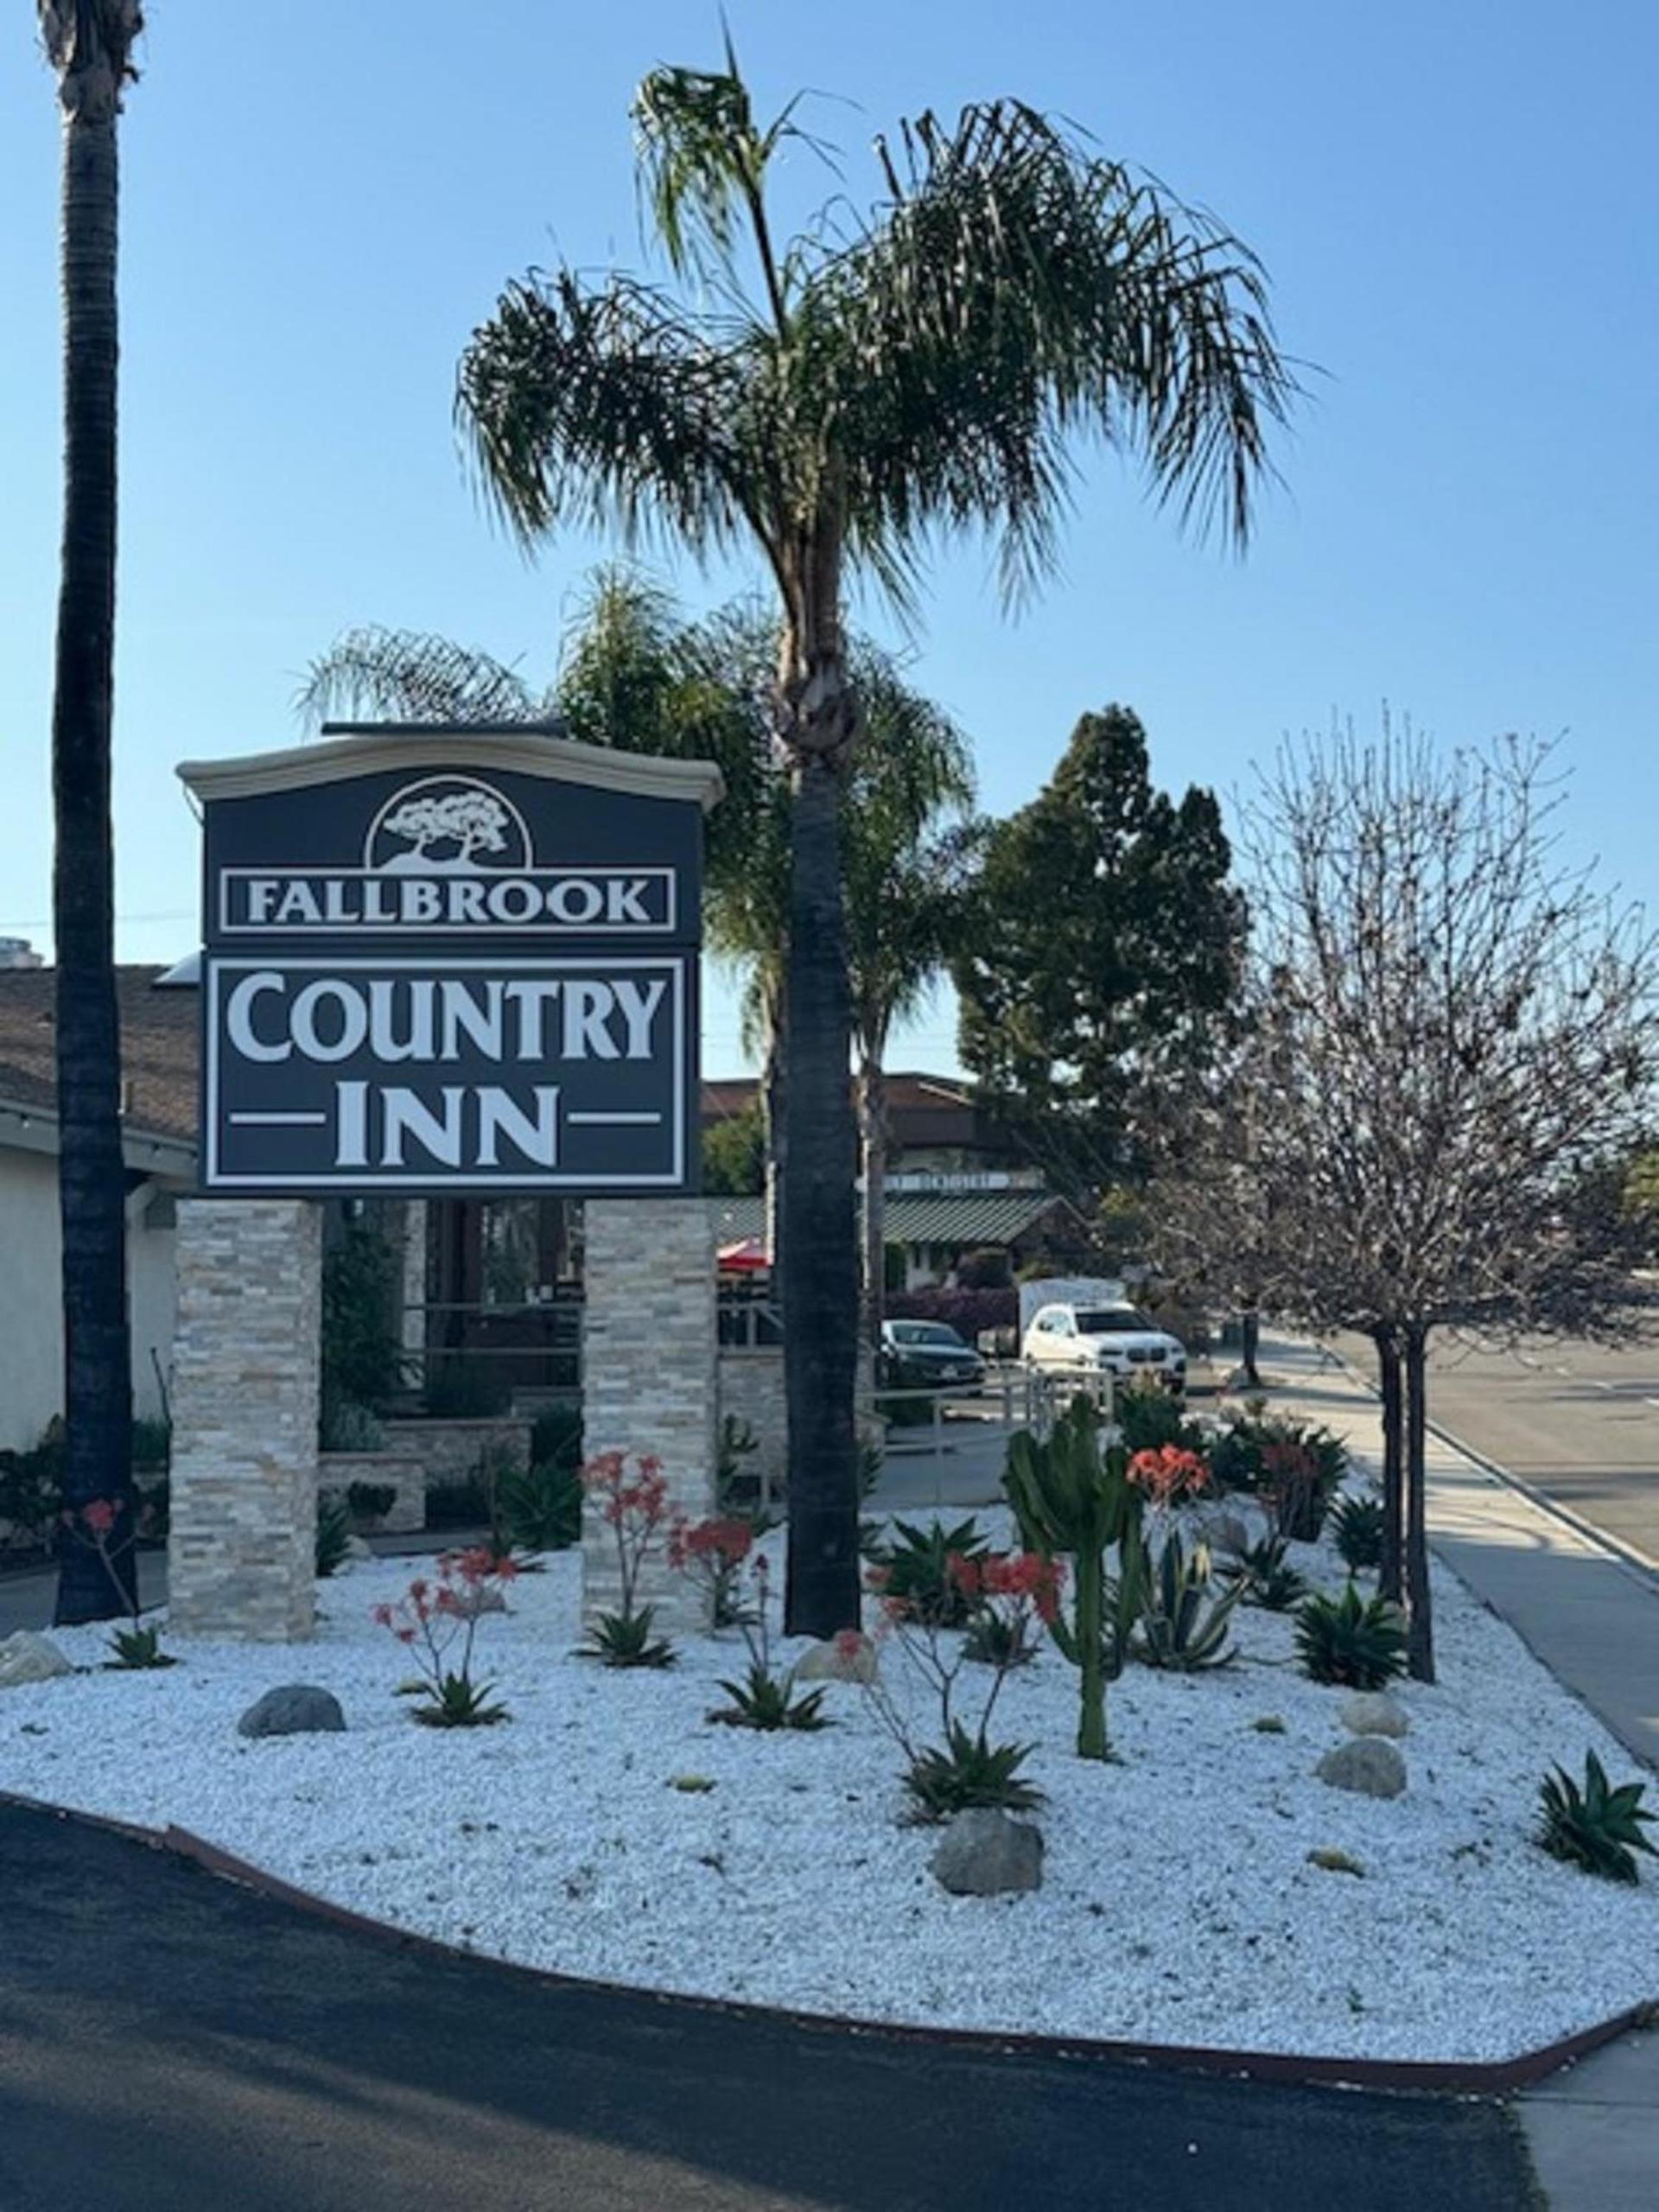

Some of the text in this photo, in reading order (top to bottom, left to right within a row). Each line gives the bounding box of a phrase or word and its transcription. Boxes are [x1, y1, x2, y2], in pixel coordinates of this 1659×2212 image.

[247, 879, 652, 924] FALLBROOK
[226, 970, 668, 1064] COUNTRY
[334, 1079, 562, 1168] INN
